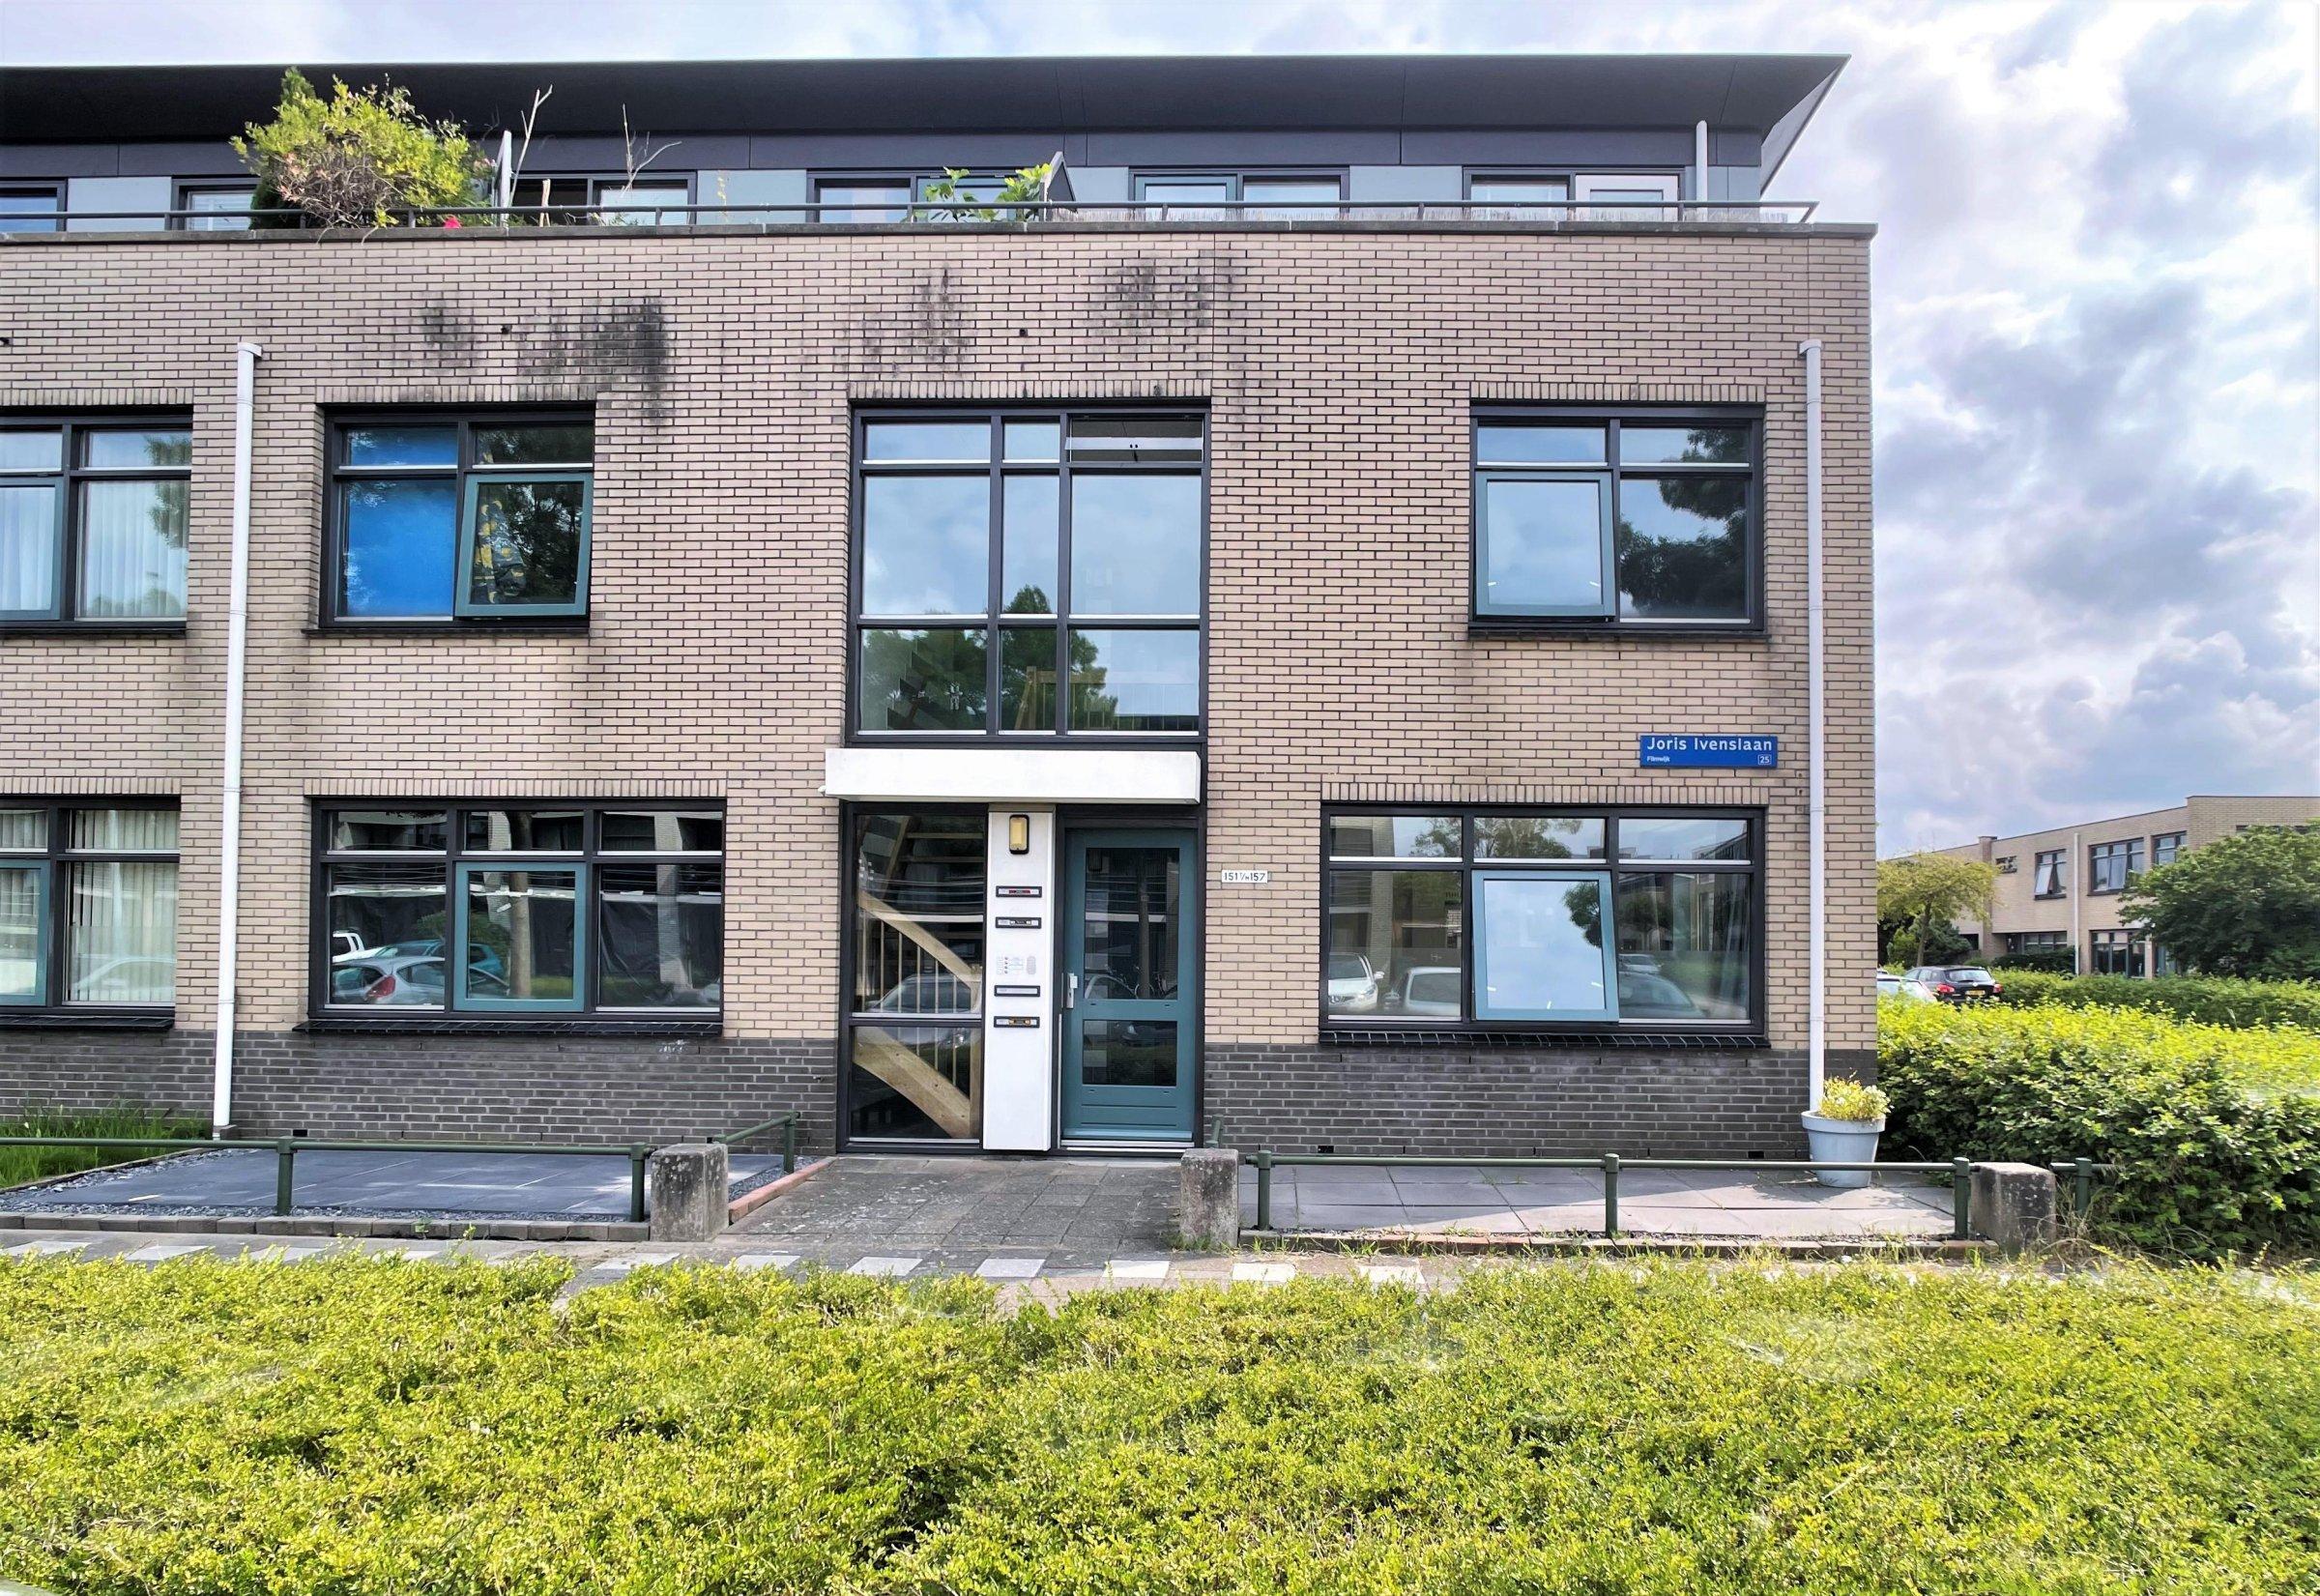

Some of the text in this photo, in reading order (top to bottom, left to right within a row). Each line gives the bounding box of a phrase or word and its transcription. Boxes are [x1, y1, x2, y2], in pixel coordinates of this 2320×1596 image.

[1646, 737, 1773, 751] Joris Ivenslaan
[1759, 755, 1770, 764] 25
